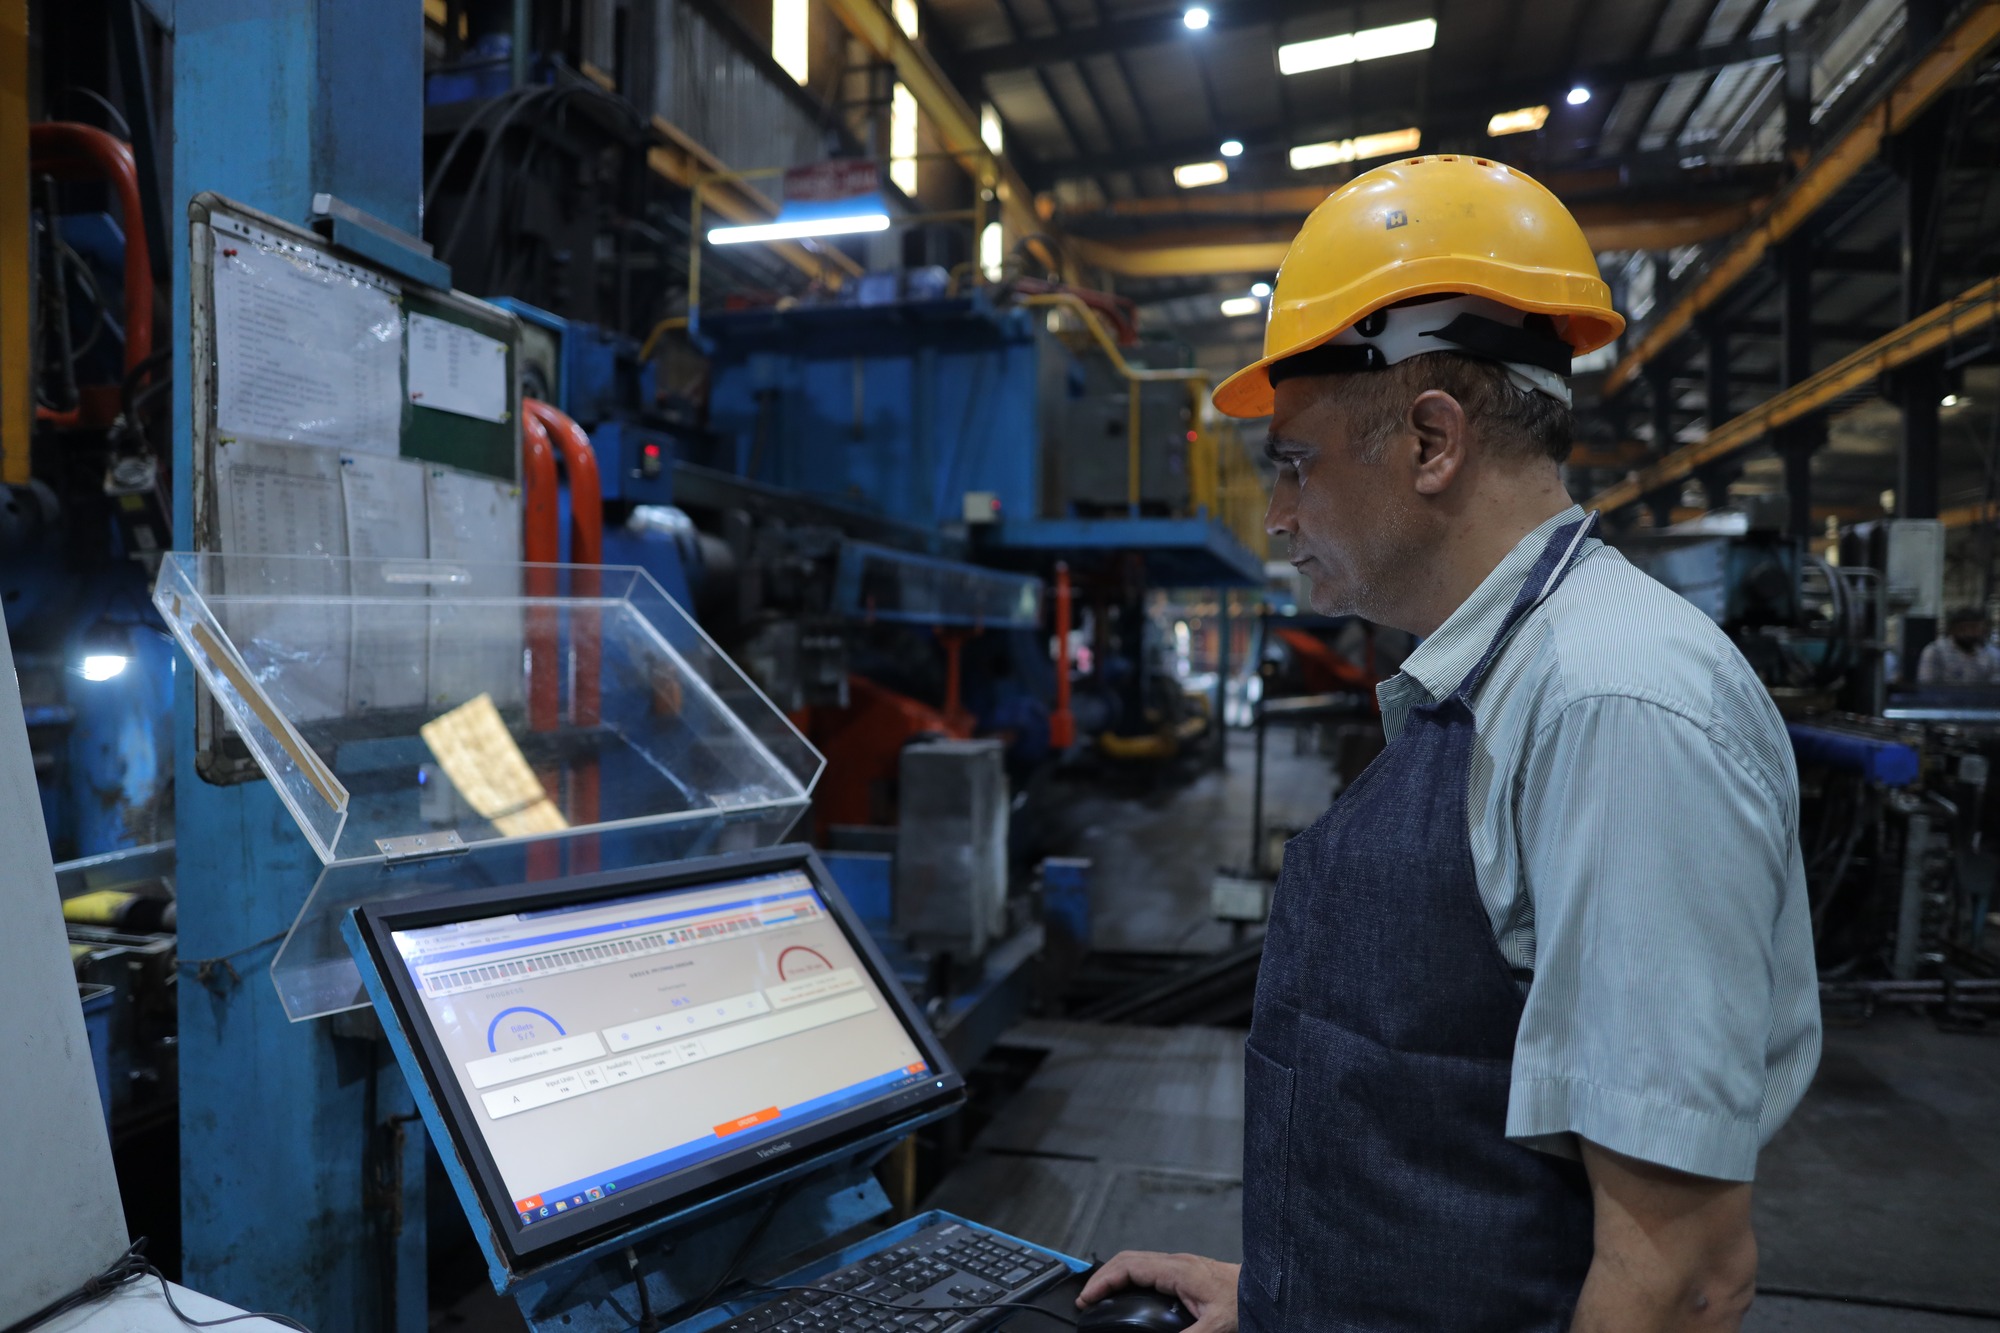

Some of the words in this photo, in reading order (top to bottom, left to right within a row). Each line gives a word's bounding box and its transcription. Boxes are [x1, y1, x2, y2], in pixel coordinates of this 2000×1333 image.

[511, 1023, 534, 1033] Billets
[513, 1095, 520, 1103] A
[756, 1141, 792, 1158] ViewSonic
